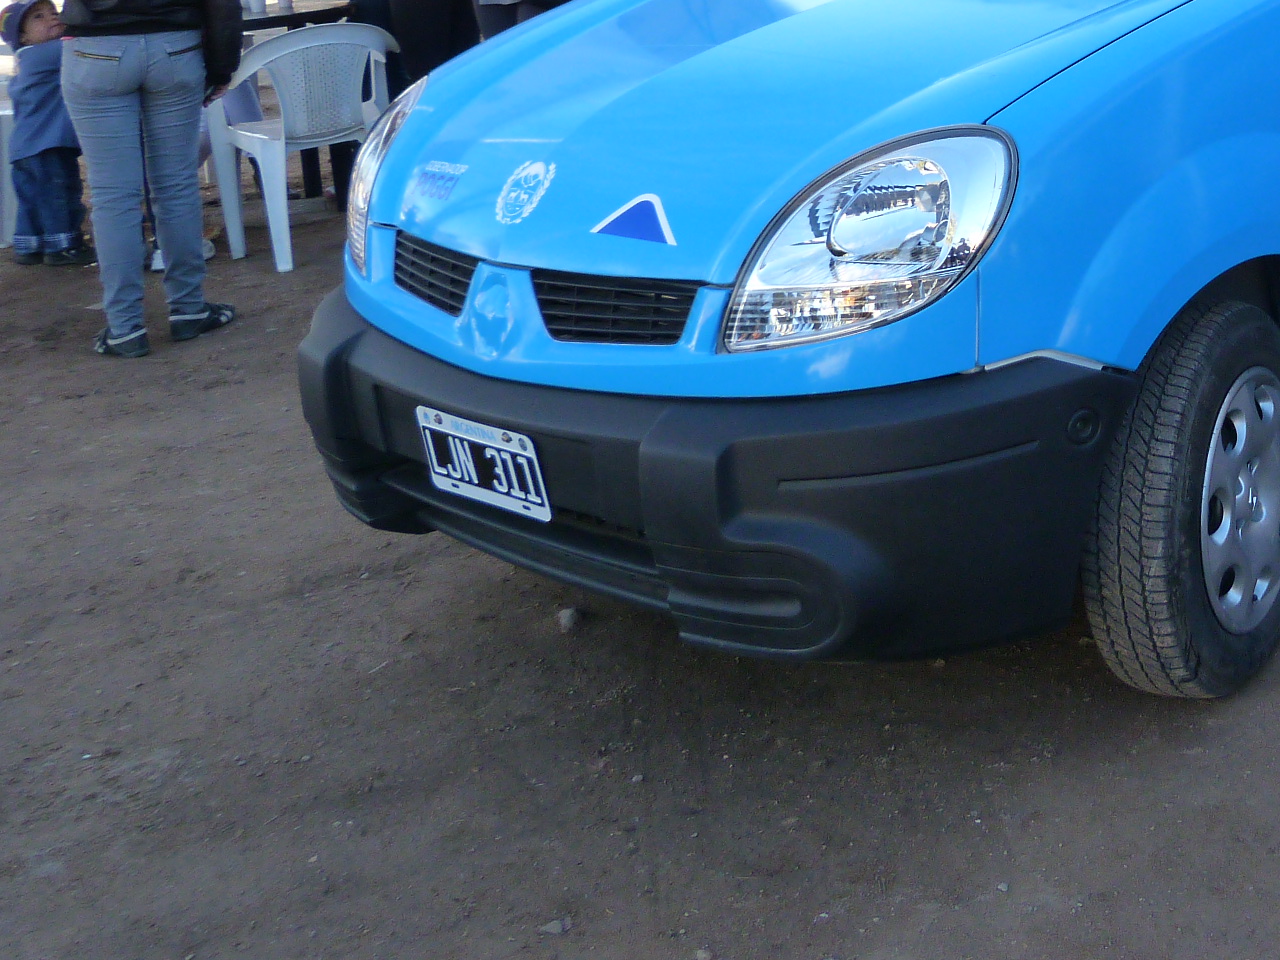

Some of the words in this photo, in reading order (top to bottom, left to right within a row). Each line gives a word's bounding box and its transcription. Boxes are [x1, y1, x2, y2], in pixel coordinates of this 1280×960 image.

[415, 172, 460, 201] POGGI
[425, 428, 479, 484] LJN
[483, 446, 542, 504] 311
